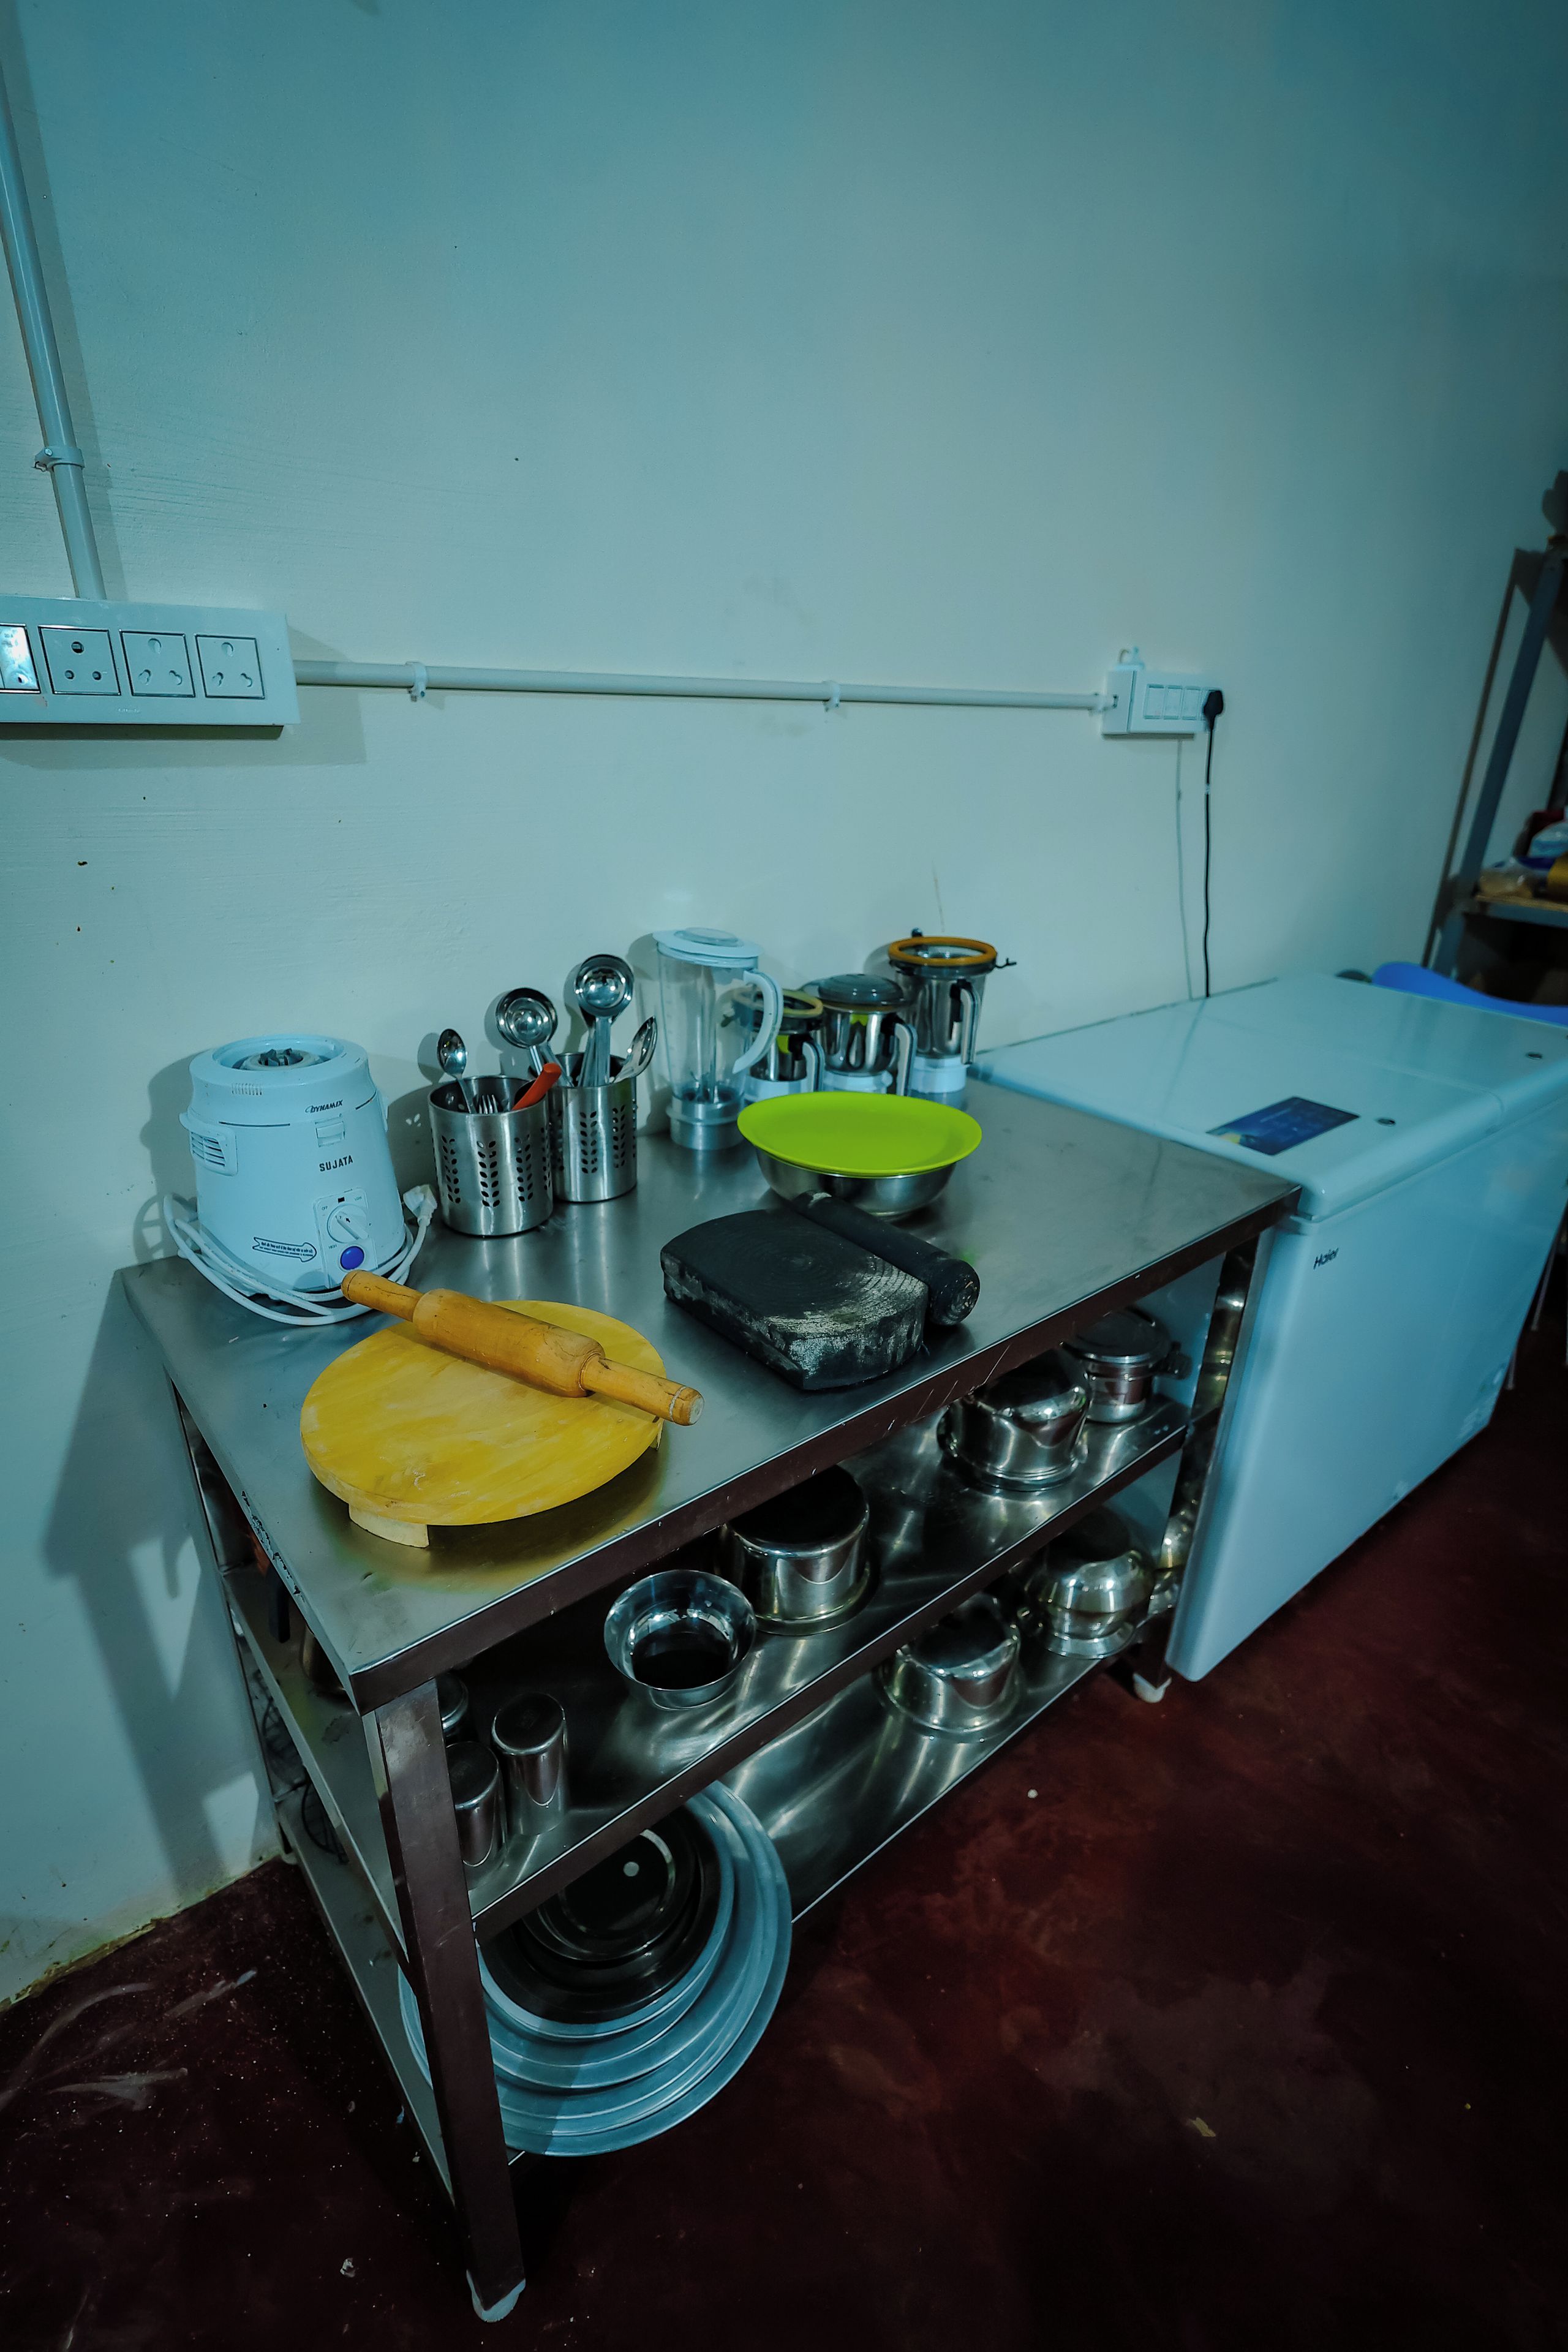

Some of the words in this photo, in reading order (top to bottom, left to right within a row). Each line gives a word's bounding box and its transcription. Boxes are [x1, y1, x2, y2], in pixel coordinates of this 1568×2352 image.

[305, 1099, 343, 1113] DYNAMIX
[319, 1155, 353, 1172] SUJATA
[1313, 1248, 1339, 1270] Haier
